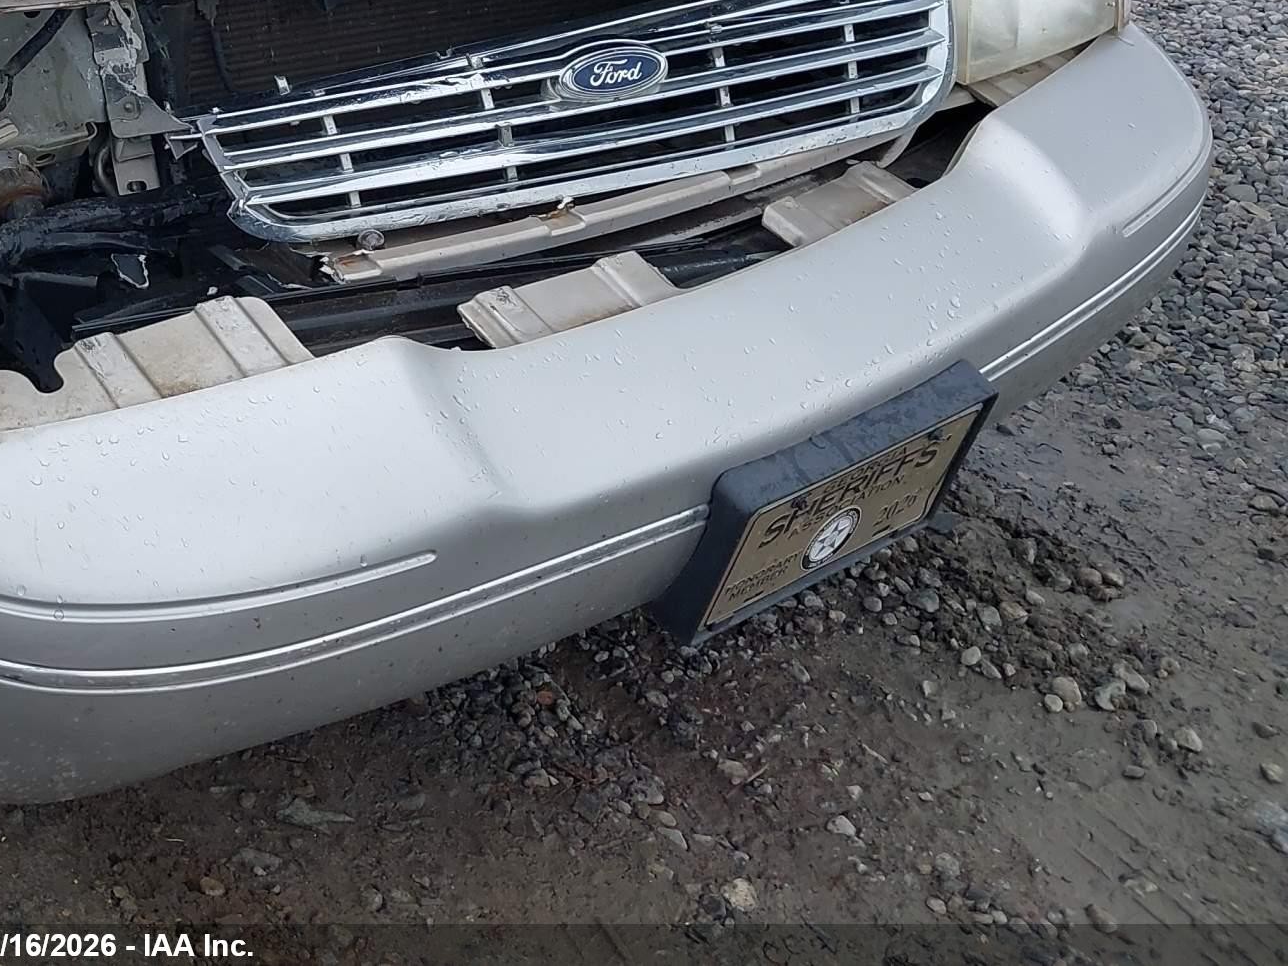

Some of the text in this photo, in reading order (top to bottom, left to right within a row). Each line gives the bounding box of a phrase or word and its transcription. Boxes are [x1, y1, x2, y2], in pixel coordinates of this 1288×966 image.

[590, 59, 642, 86] Ford
[758, 440, 940, 548] SHERIFFS
[787, 475, 905, 539] ASSOCIATION
[725, 551, 800, 594] HONORARY
